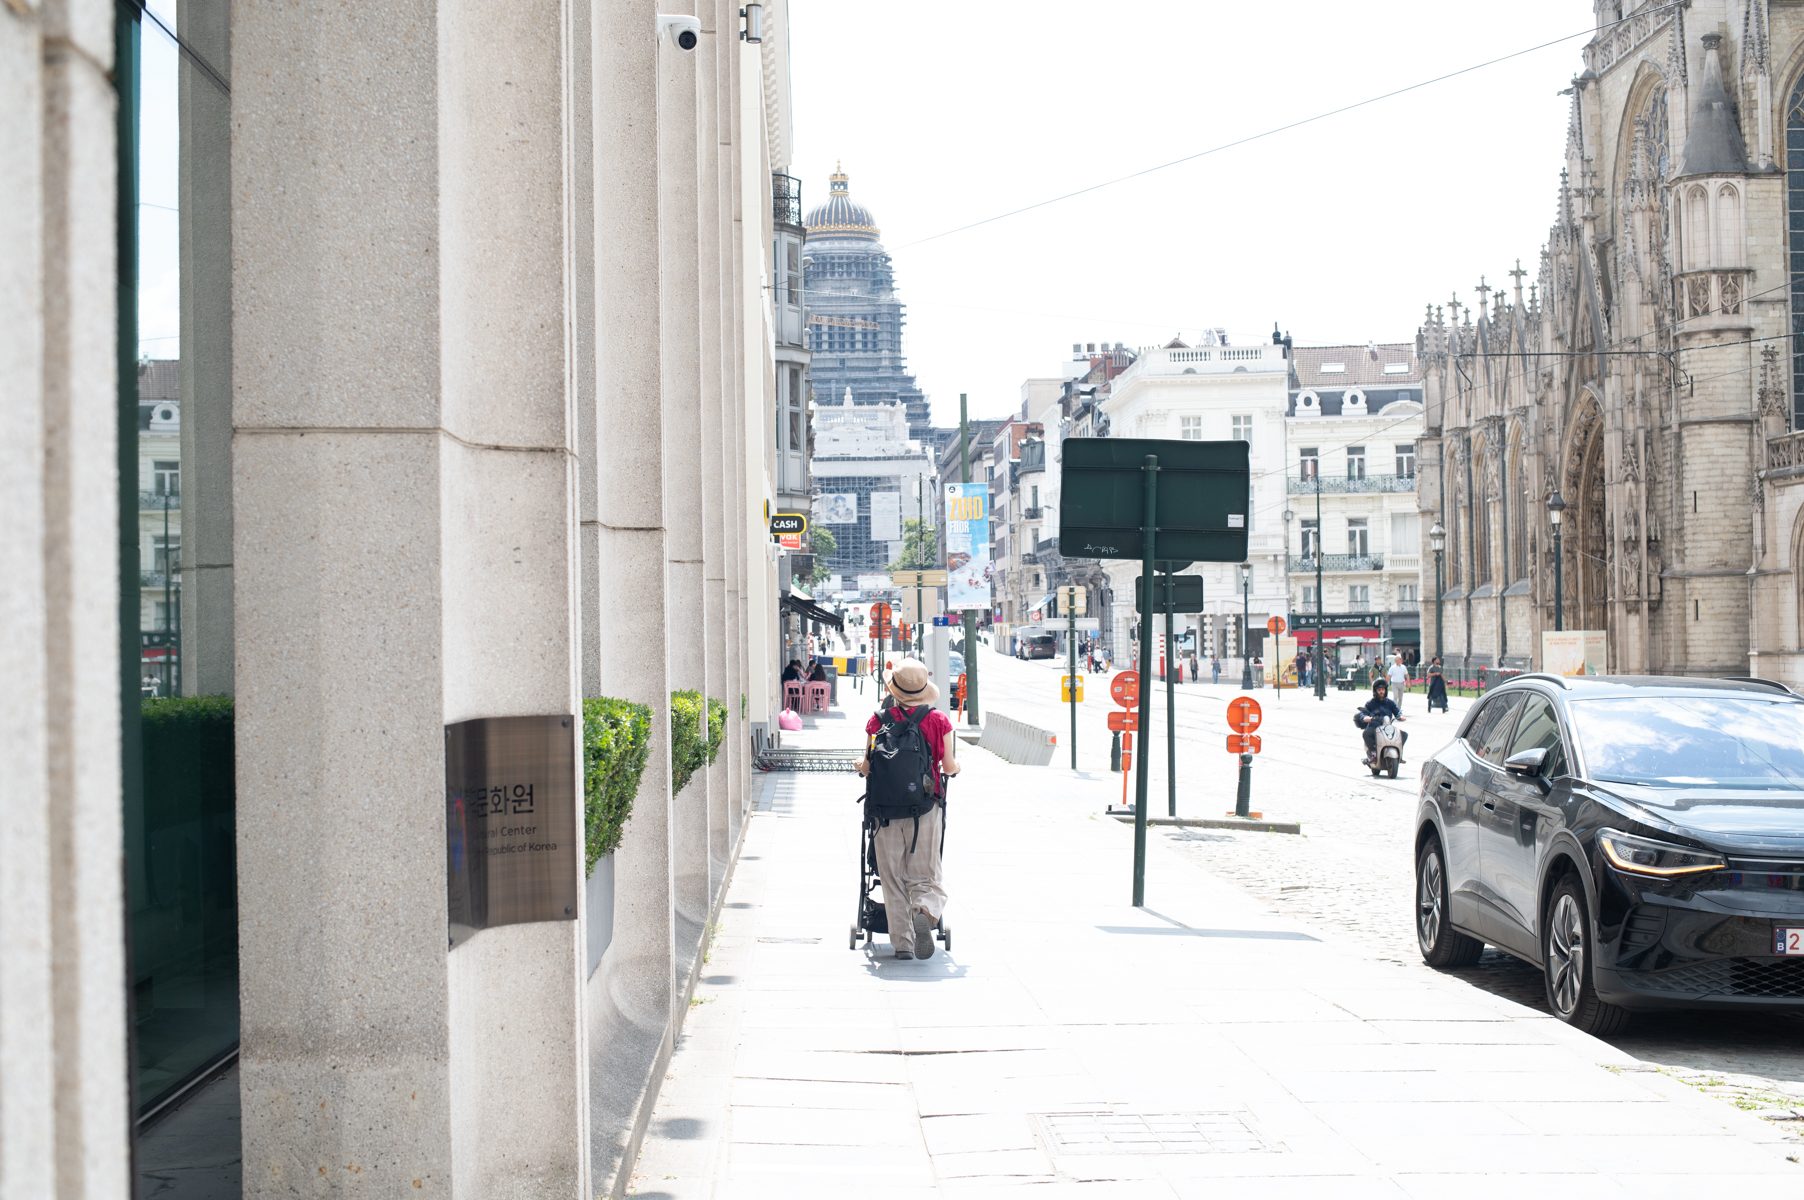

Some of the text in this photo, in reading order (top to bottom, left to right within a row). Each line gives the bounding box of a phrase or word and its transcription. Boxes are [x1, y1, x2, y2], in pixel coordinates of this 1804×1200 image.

[949, 495, 984, 521] ZUID
[773, 520, 798, 529] CASH
[500, 826, 537, 837] Center
[517, 842, 527, 853] of
[528, 842, 558, 852] Korea
[1777, 933, 1800, 951] B 2
